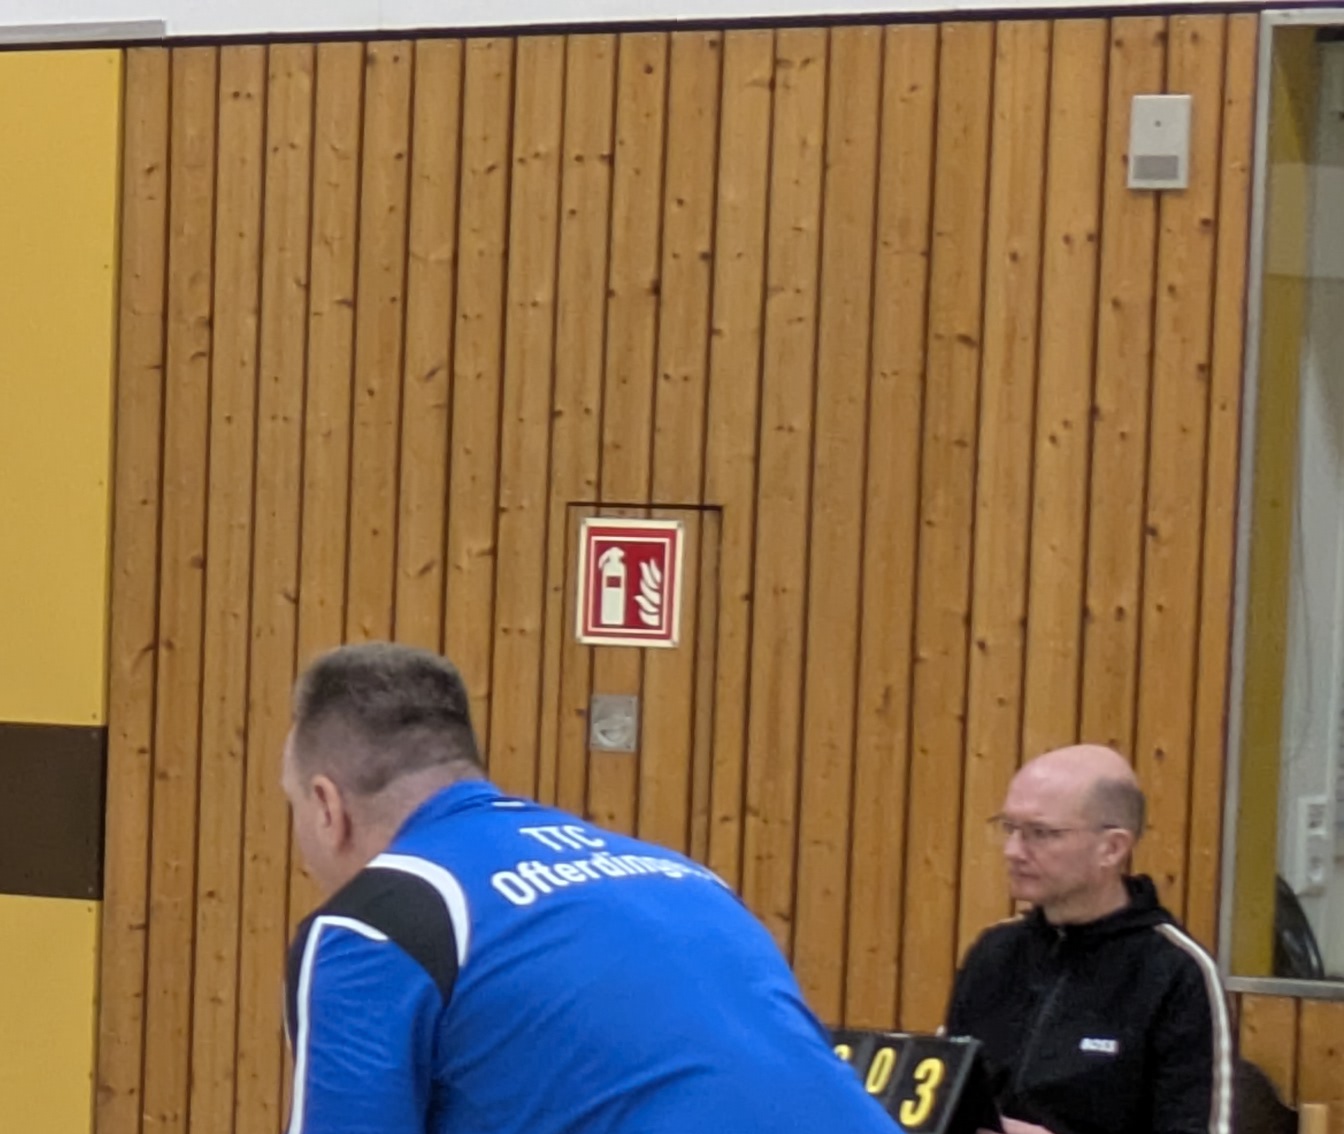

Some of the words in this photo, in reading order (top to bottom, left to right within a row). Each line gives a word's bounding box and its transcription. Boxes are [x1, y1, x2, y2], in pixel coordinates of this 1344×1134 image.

[518, 825, 606, 851] TTC
[491, 851, 722, 905] Ofterding
[900, 1058, 945, 1127] 3
